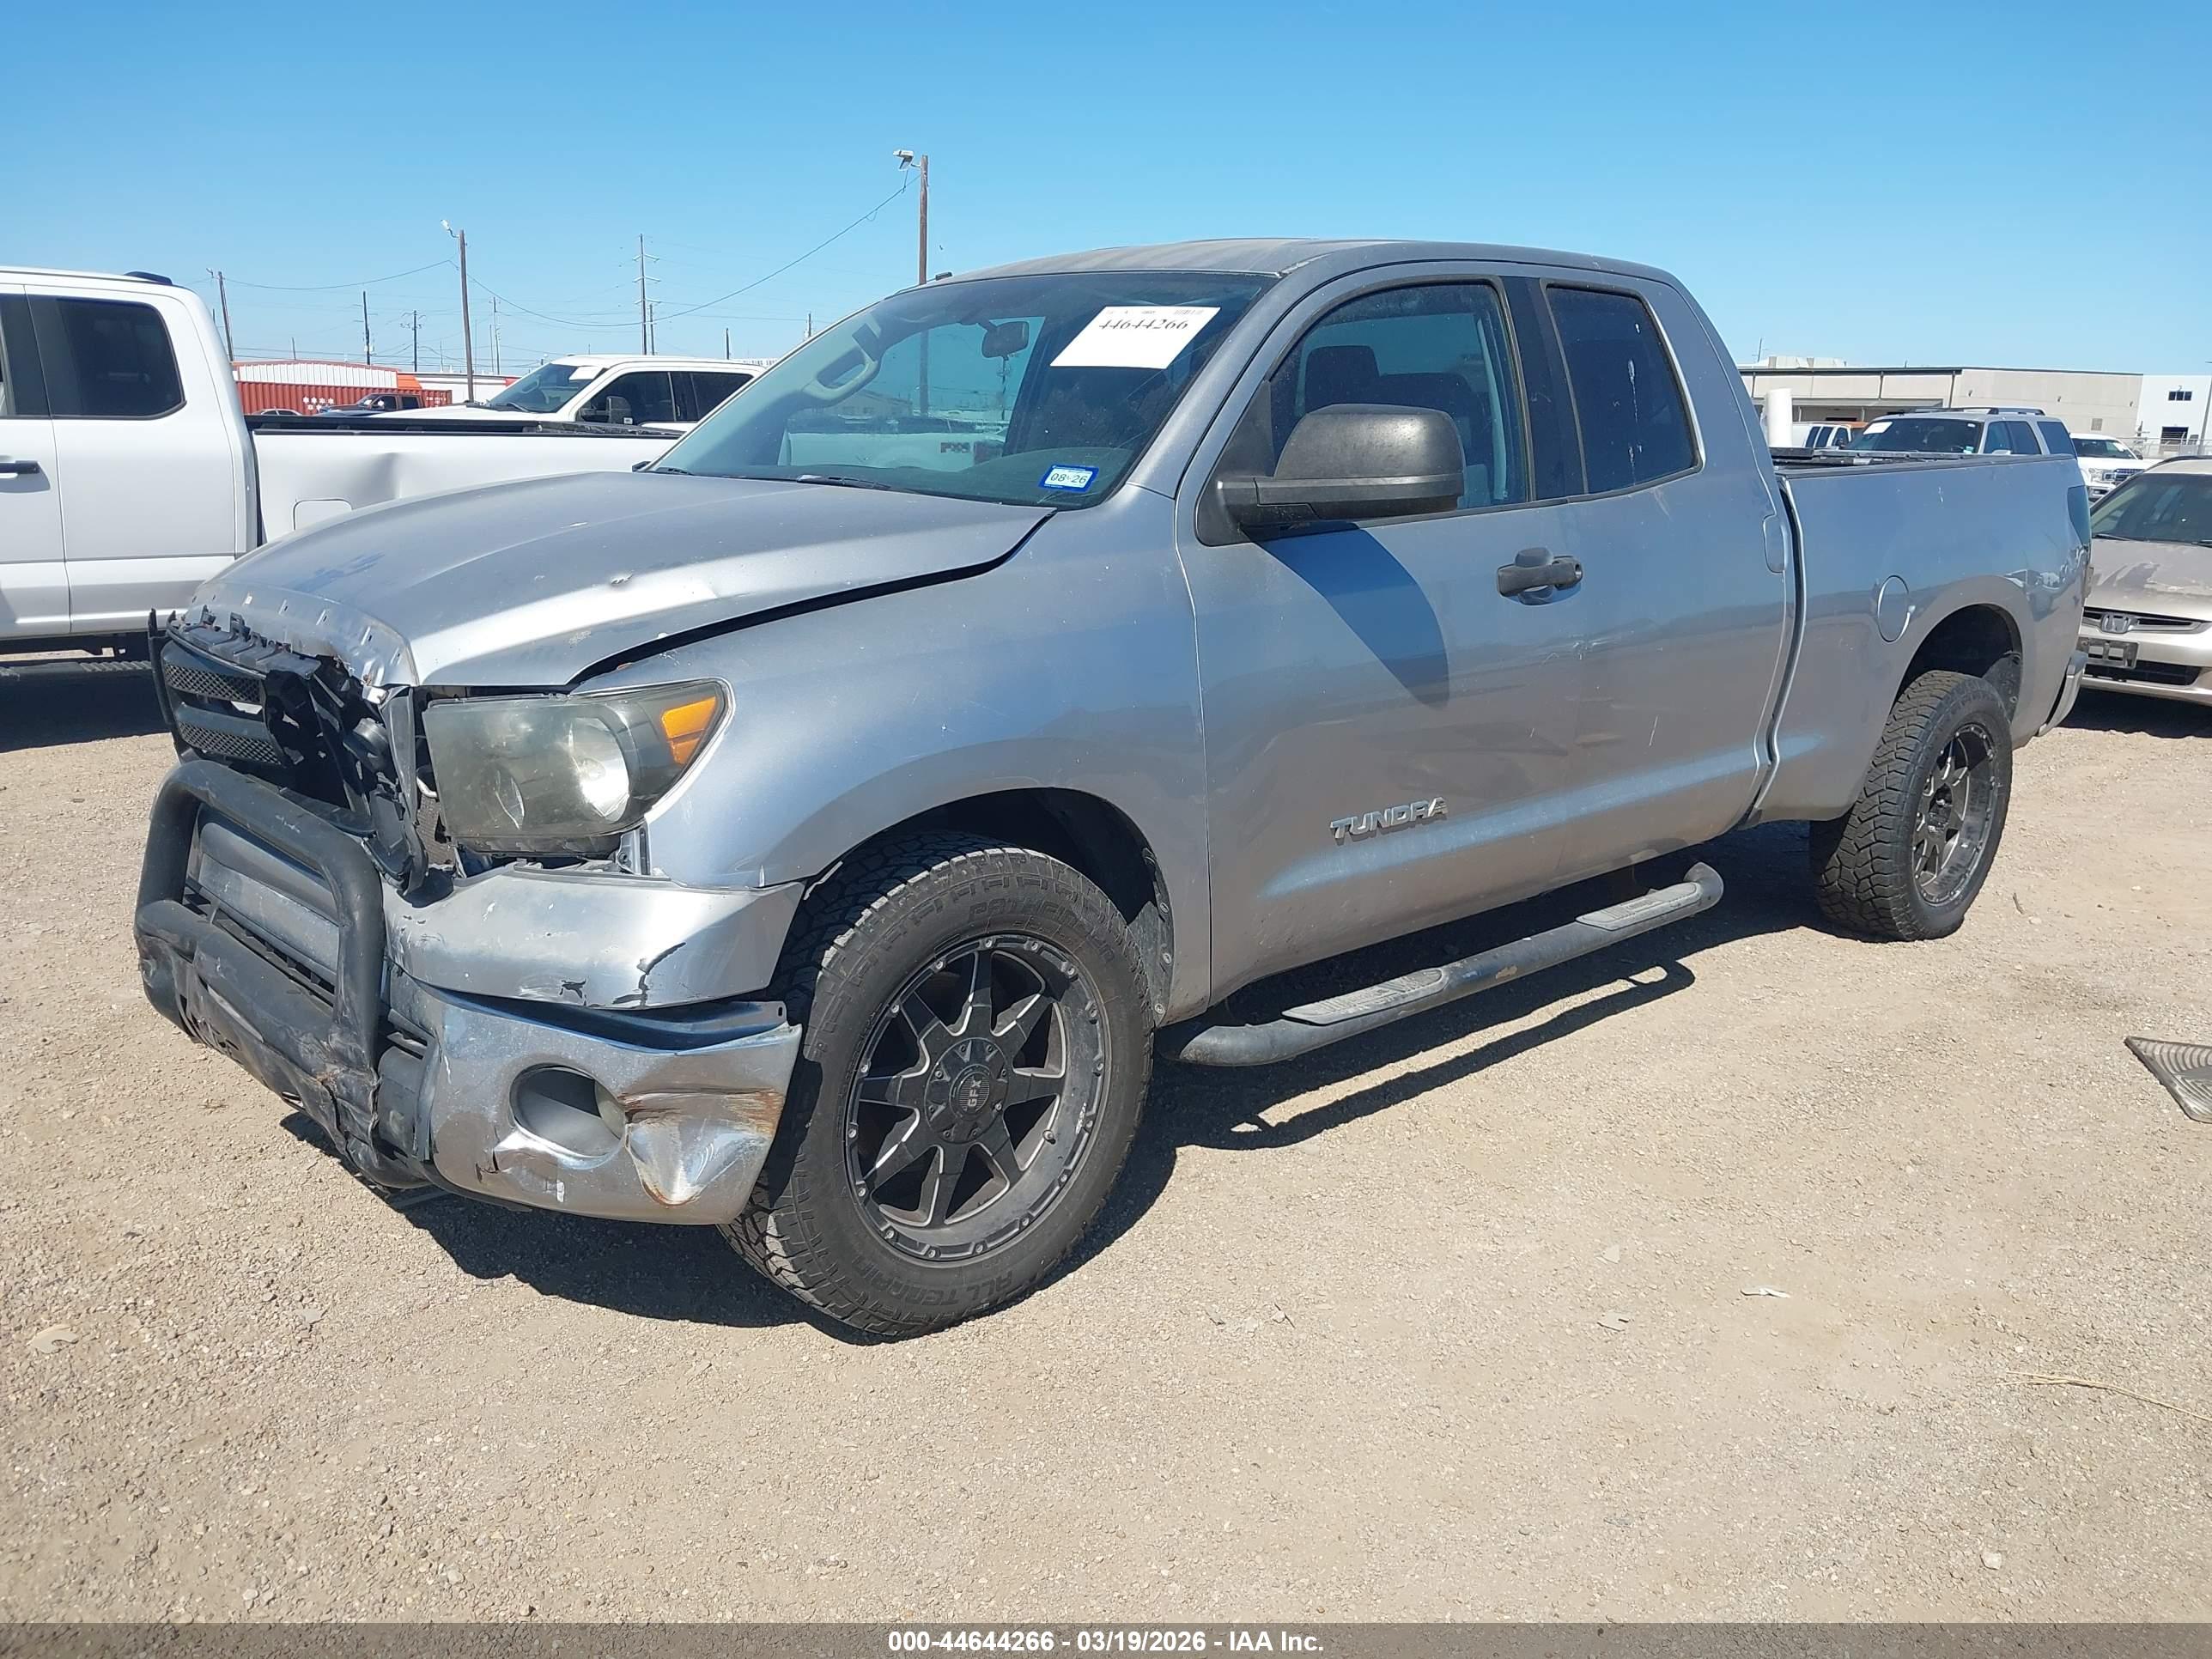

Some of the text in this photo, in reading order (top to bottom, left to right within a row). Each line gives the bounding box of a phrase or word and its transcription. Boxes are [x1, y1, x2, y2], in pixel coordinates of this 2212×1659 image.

[1099, 319, 1188, 329] 44644266
[1330, 796, 1449, 839] TUNDRA
[968, 1079, 982, 1107] GFX
